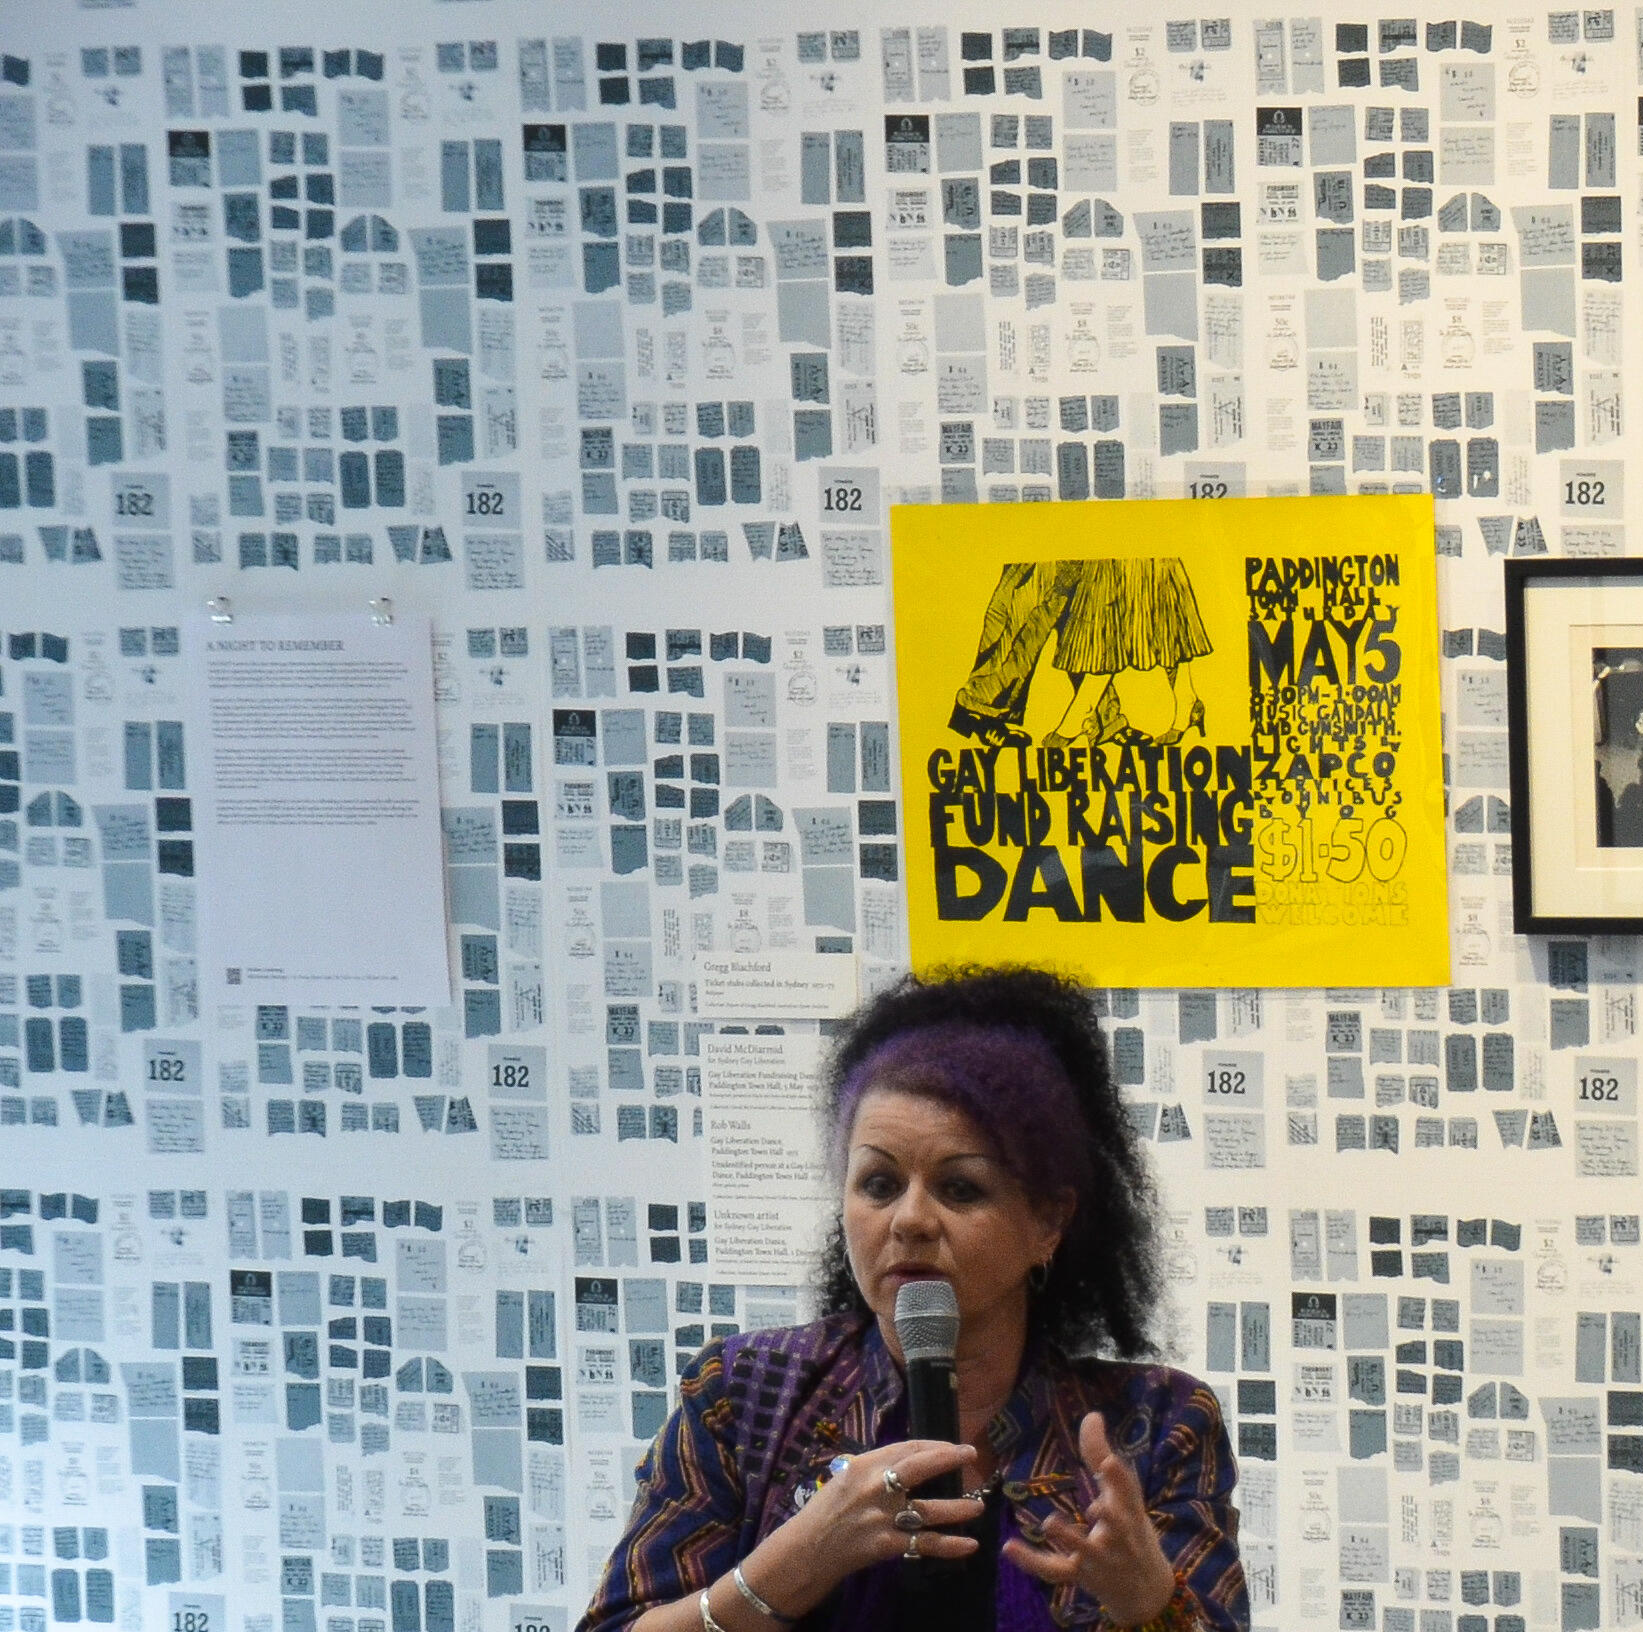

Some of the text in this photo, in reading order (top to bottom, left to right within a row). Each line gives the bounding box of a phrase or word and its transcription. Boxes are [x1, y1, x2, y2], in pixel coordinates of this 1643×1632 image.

[116, 492, 154, 516] 182
[466, 492, 504, 515] 182
[824, 487, 862, 512] 182
[1565, 480, 1605, 505] 182
[1245, 554, 1400, 596] PADDINGTON
[1250, 586, 1380, 609] TOWN HALL
[1250, 605, 1399, 620] SATURDAY
[1247, 613, 1401, 687] MAY 5
[1250, 704, 1308, 721] MUSIC
[1251, 720, 1291, 736] AND
[1252, 735, 1366, 753] LIGHTS
[927, 746, 1252, 793] GAY LIBERATION
[1253, 752, 1396, 780] ZAPCO
[1260, 778, 1392, 791] SERVICES
[1281, 791, 1402, 805] OMNIBUS
[929, 790, 1255, 847] FUND RAISING
[935, 845, 1256, 924] DANCE
[1255, 881, 1409, 905] DONATIONS
[1259, 903, 1409, 926] WELCOME
[149, 1059, 185, 1082] 182
[493, 1064, 529, 1088] 182
[1207, 1070, 1246, 1095] 182
[1579, 1077, 1619, 1101] 182
